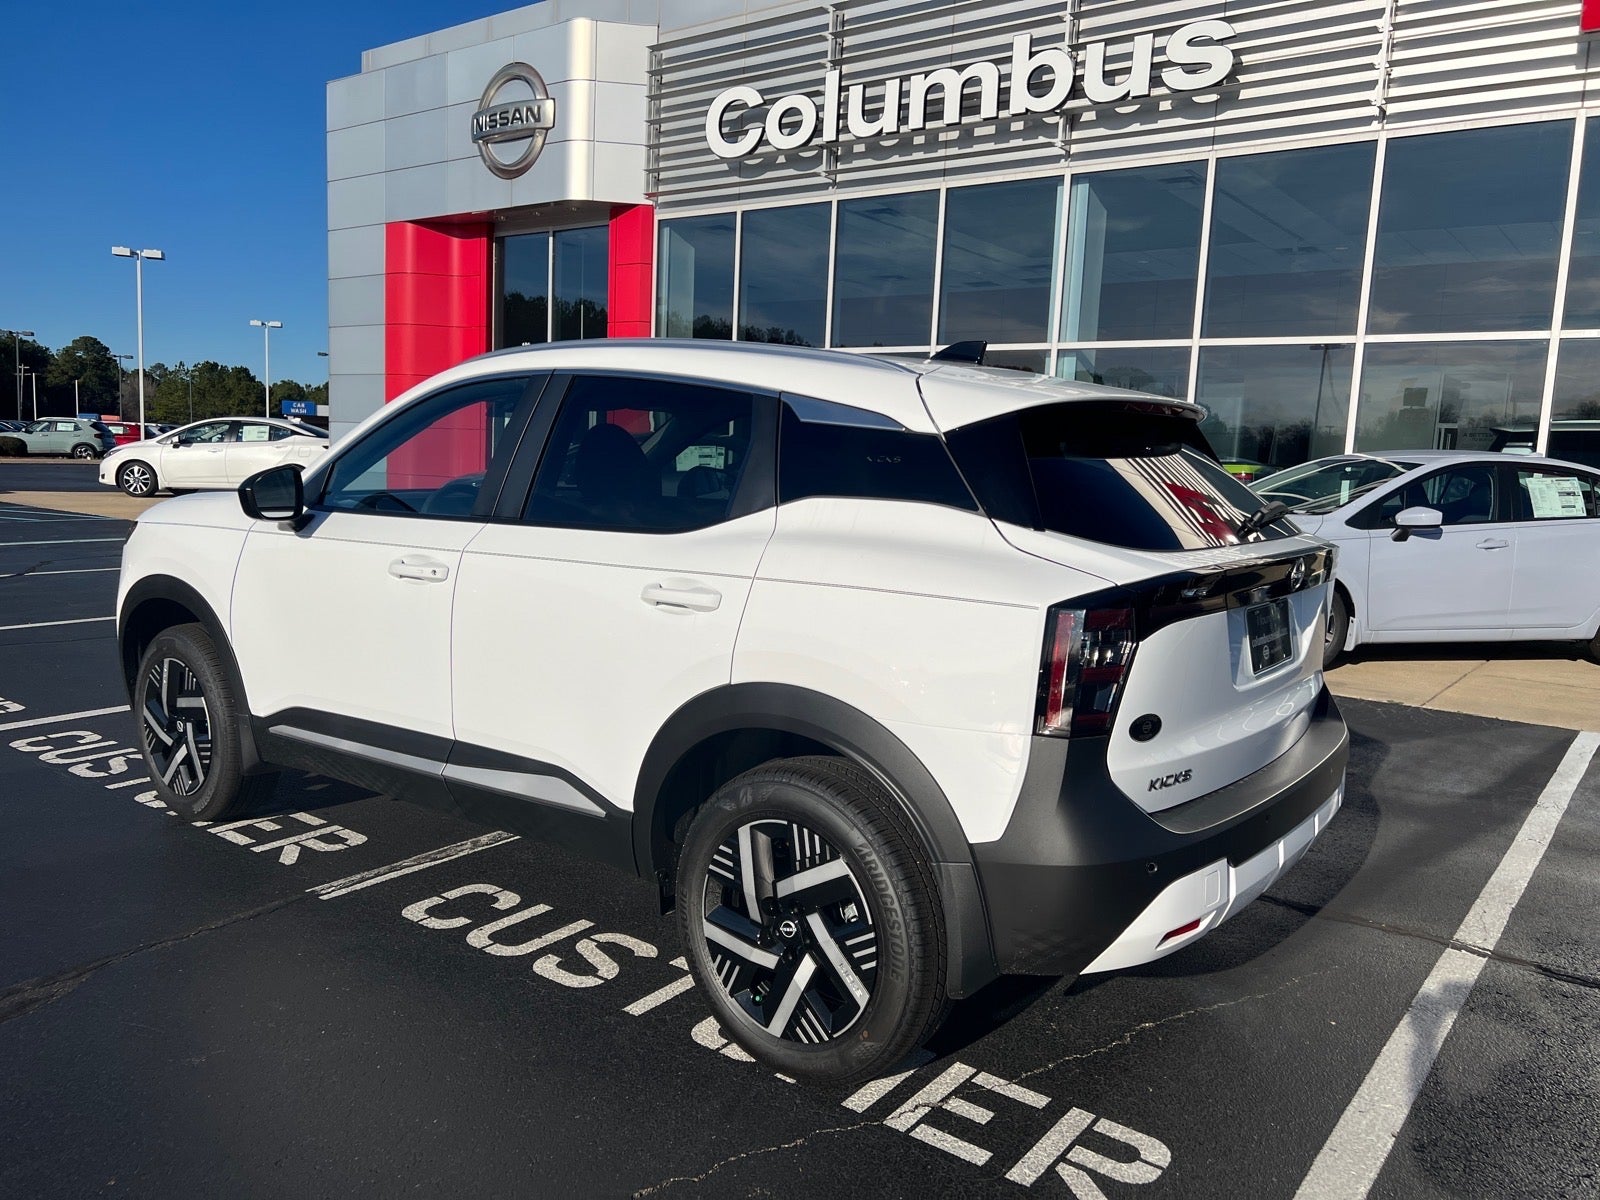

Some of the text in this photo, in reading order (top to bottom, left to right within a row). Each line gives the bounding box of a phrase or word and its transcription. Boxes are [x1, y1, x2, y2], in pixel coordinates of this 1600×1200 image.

[705, 19, 1237, 159] Columbus
[473, 105, 541, 134] NISSAN
[1146, 768, 1192, 792] KICKS
